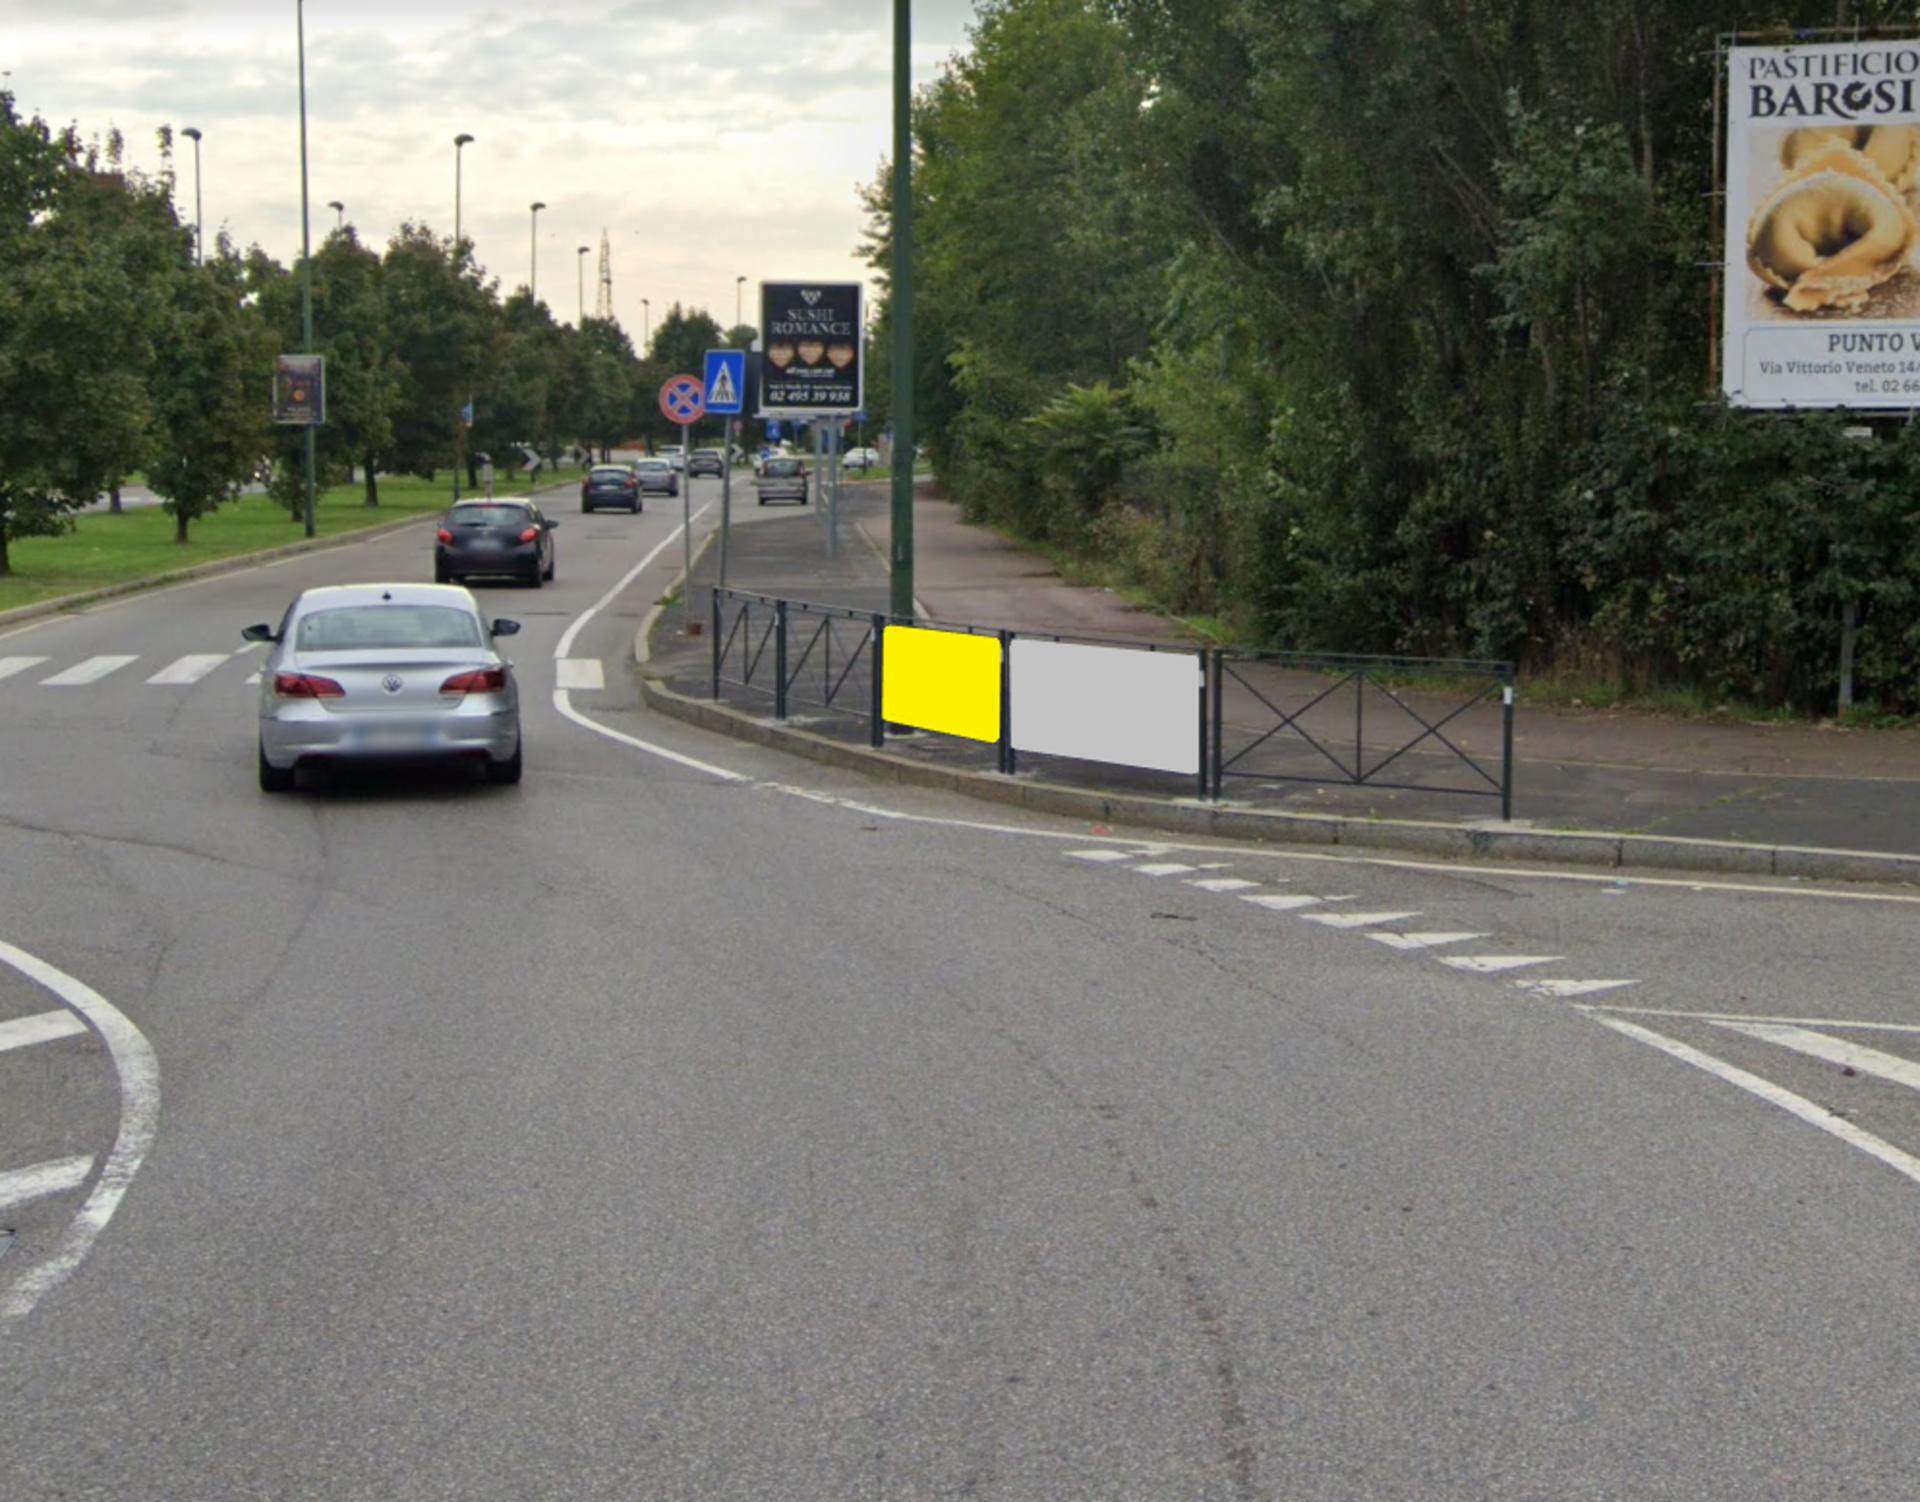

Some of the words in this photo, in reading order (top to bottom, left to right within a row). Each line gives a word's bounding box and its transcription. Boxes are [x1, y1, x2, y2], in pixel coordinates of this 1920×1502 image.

[1749, 51, 1920, 79] PASTIFICIO
[787, 308, 834, 321] SUSHI
[770, 321, 851, 335] ROMANCE
[1828, 333, 1903, 352] PUNTO
[1760, 361, 1782, 375] Via
[1786, 360, 1842, 374] Vittorio
[1846, 361, 1895, 374] Veneto
[1855, 380, 1878, 392] tel.
[1882, 380, 1899, 392] 02
